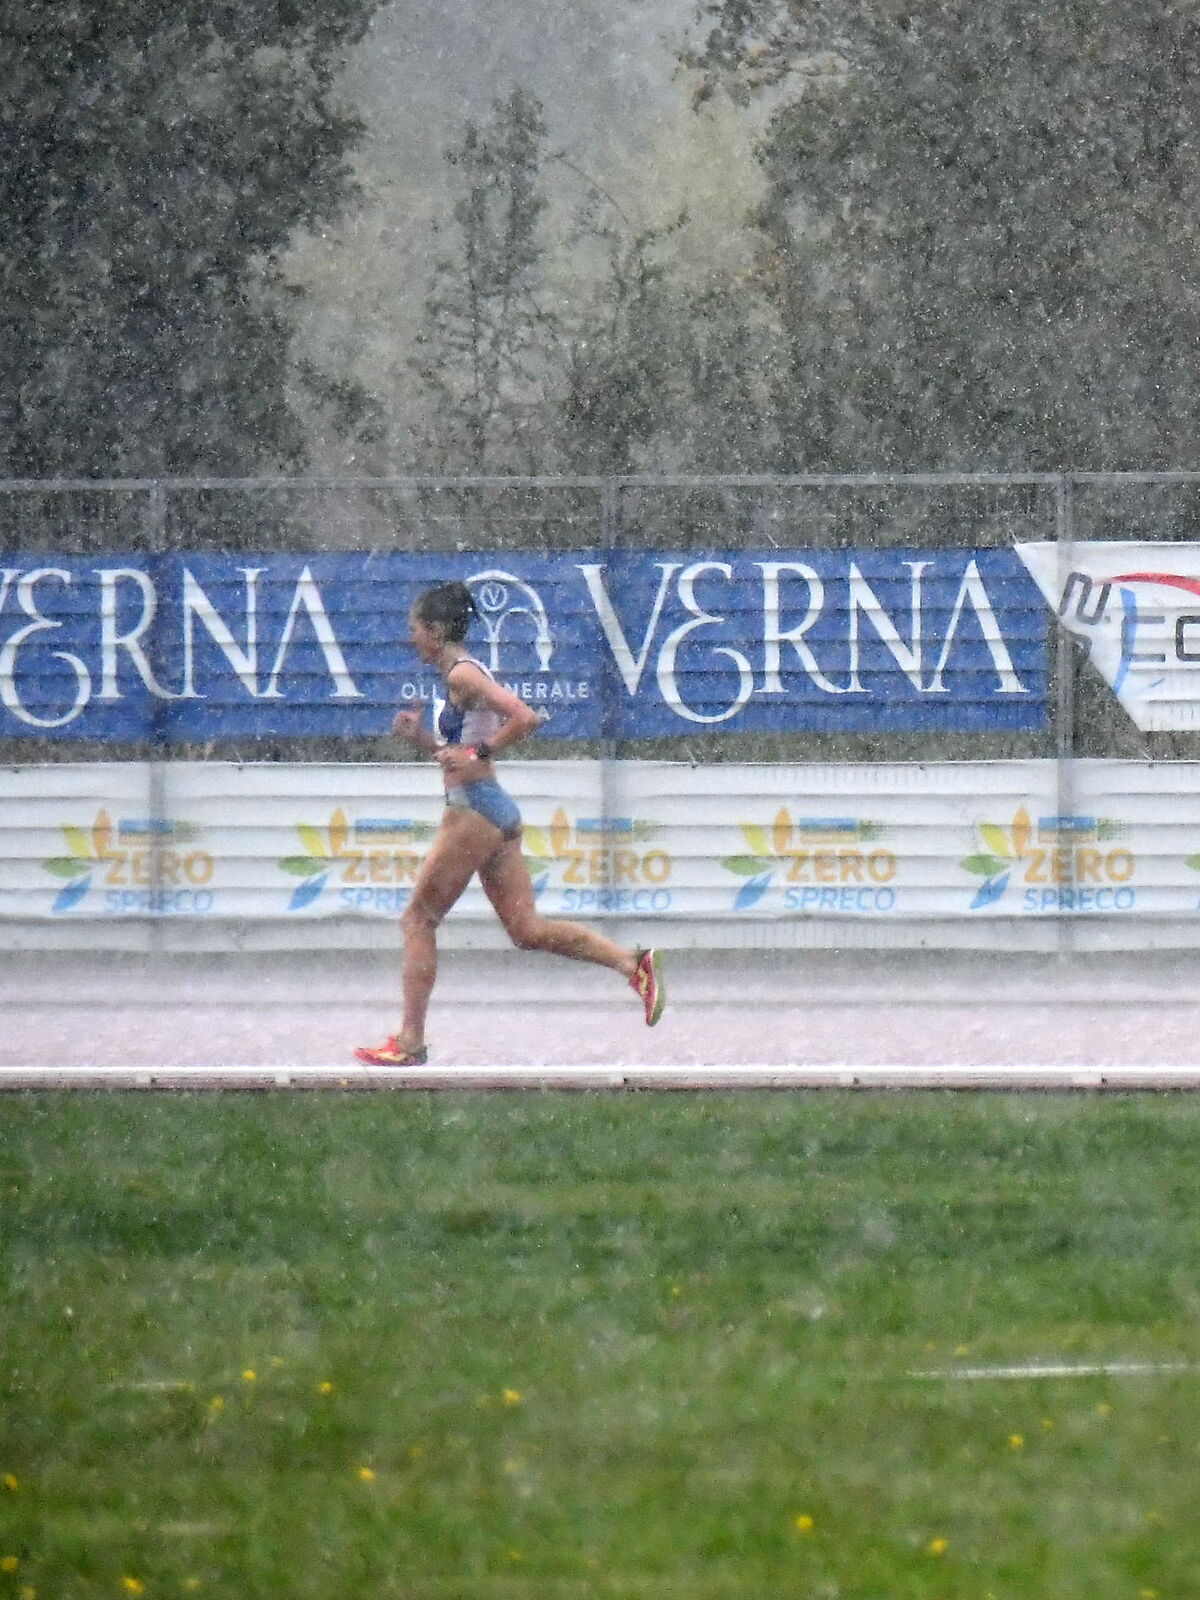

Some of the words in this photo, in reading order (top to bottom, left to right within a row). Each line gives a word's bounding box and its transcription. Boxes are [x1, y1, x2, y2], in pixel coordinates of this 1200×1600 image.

[575, 559, 1030, 724] VERNA
[105, 850, 214, 884] ZERO
[340, 850, 420, 883] ZER
[561, 849, 672, 884] ZERO
[783, 848, 896, 883] ZERO
[1023, 848, 1135, 883] ZERO
[339, 887, 412, 912] SPRE
[784, 886, 895, 911] SPRECO
[1023, 885, 1135, 911] SPRECO
